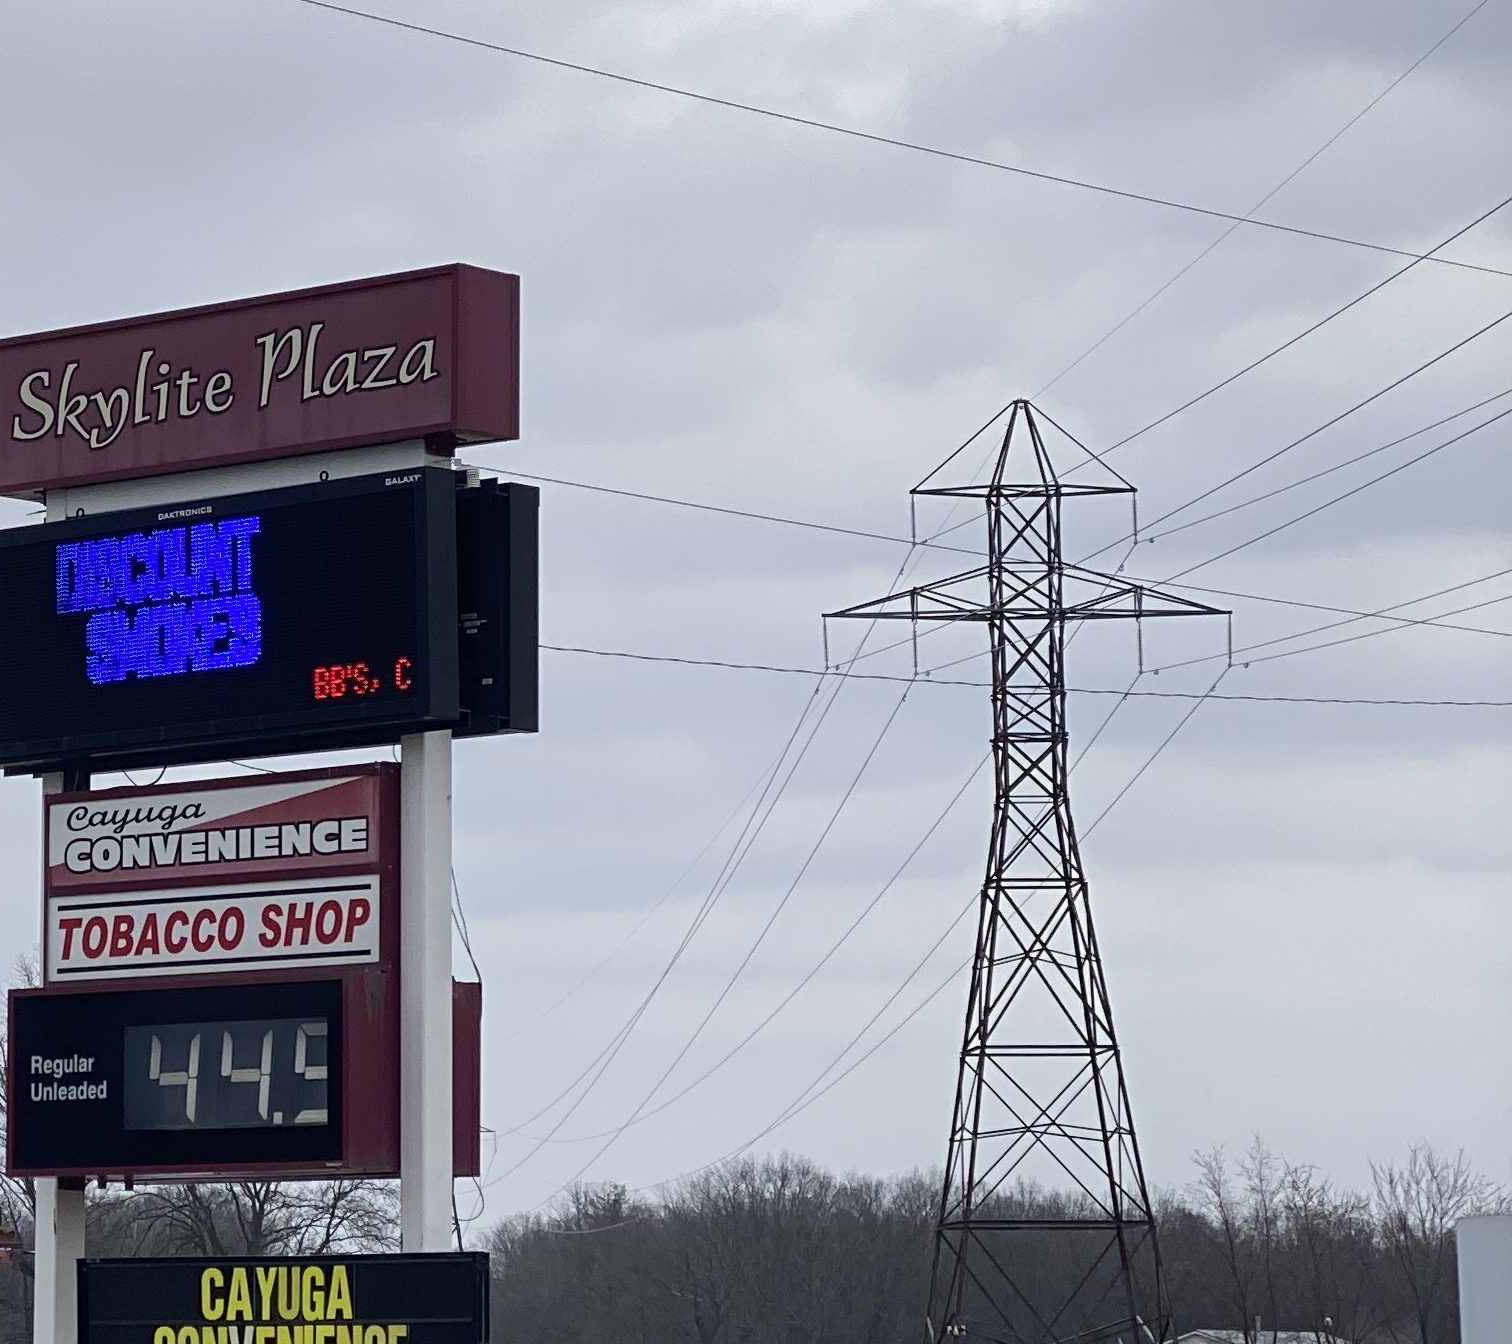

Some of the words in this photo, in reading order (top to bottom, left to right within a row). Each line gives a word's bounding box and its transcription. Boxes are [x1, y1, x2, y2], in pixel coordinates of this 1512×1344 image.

[11, 349, 234, 448] Skylite
[256, 323, 439, 408] Plaza
[385, 474, 419, 486] GALAXY
[395, 657, 412, 689] C
[67, 801, 205, 834] Cayuga
[65, 818, 369, 873] CONVENIENCE
[58, 907, 245, 960] TOBACCO
[258, 898, 370, 948] SHOP
[31, 1054, 94, 1076] Regular
[31, 1081, 107, 1101] Unleaded
[201, 1265, 353, 1321] CAYUGA
